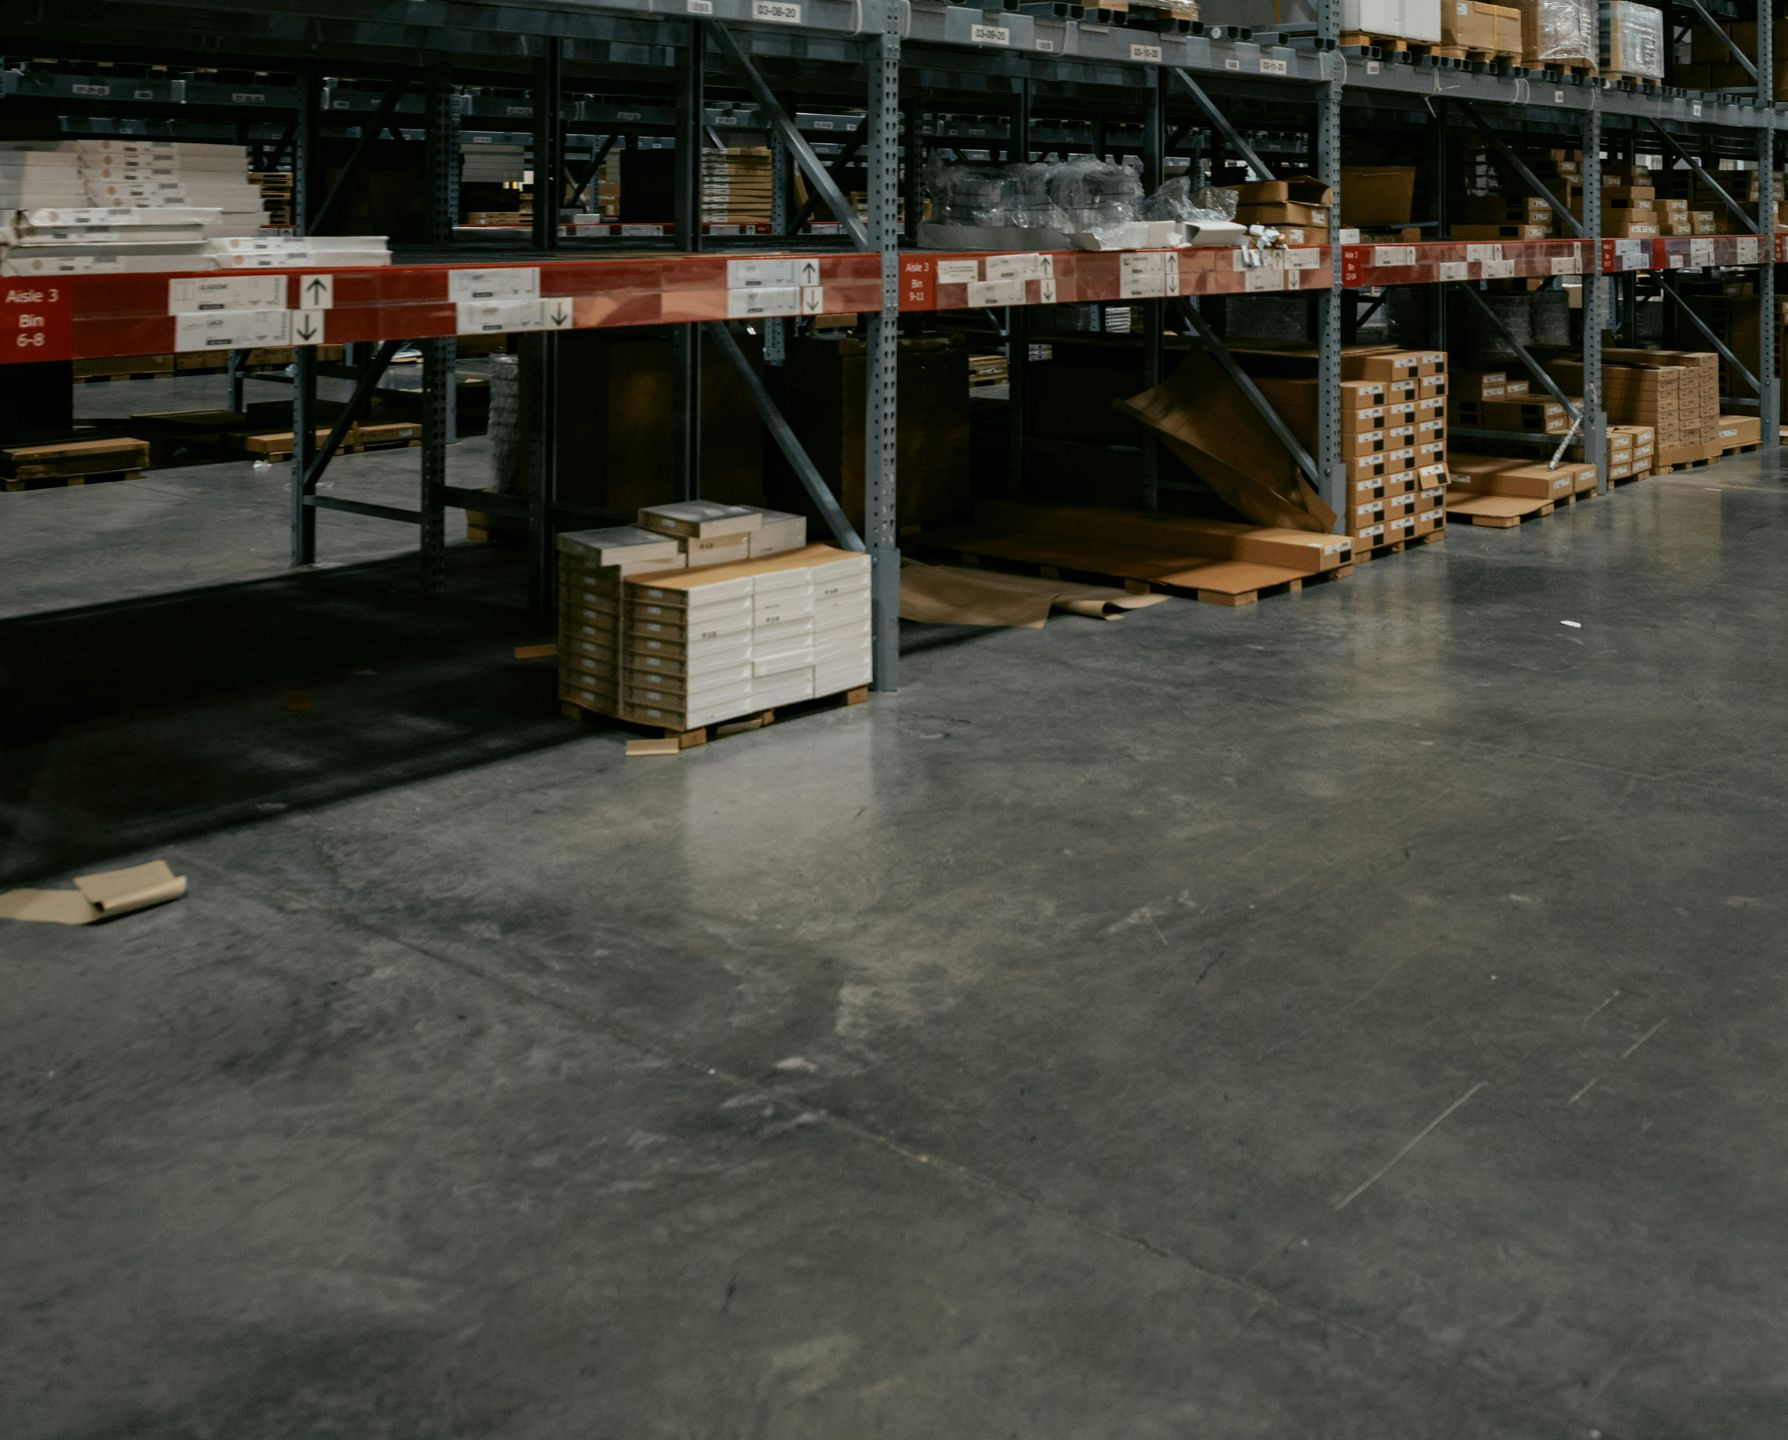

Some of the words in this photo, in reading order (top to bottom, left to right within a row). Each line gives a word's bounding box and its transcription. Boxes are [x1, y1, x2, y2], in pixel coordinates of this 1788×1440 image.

[757, 5, 796, 18] 03-08-20
[905, 263, 923, 272] Aisle
[924, 262, 930, 272] 3
[911, 279, 923, 288] Bin
[5, 289, 44, 303] Aisle
[48, 288, 60, 302] 3
[909, 292, 925, 301] 9-11
[19, 314, 45, 327] Bin
[17, 332, 45, 347] 6-8
